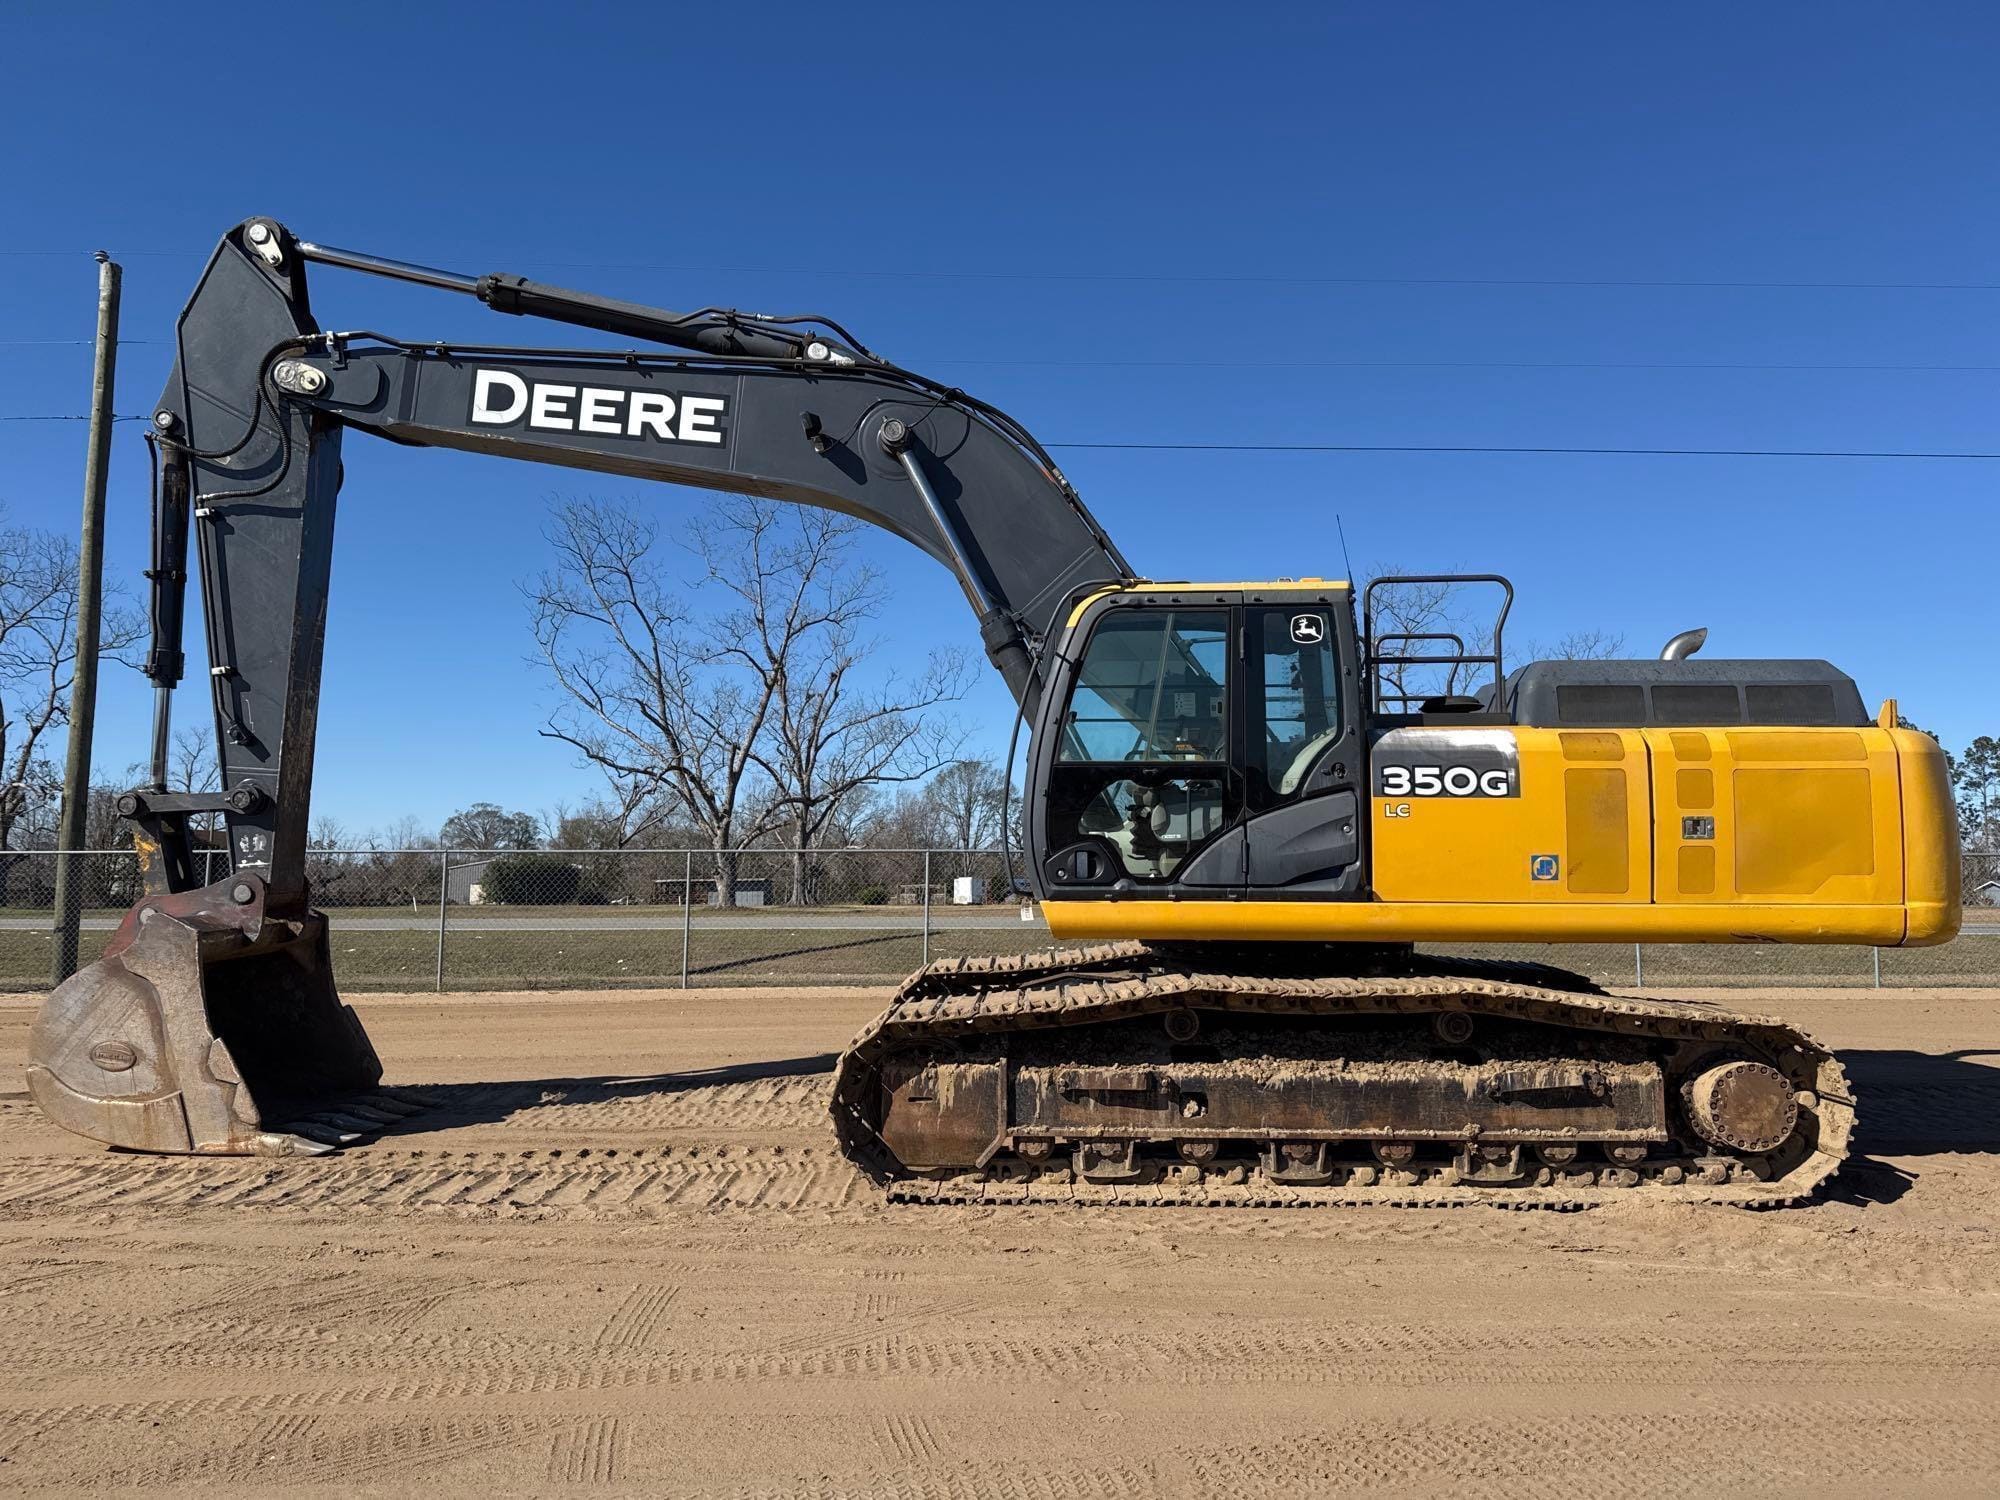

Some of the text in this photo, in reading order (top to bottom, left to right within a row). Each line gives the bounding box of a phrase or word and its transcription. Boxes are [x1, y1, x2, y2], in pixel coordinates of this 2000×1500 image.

[472, 369, 725, 443] DEERE
[1382, 766, 1509, 797] 350G
[1385, 803, 1411, 818] LC
